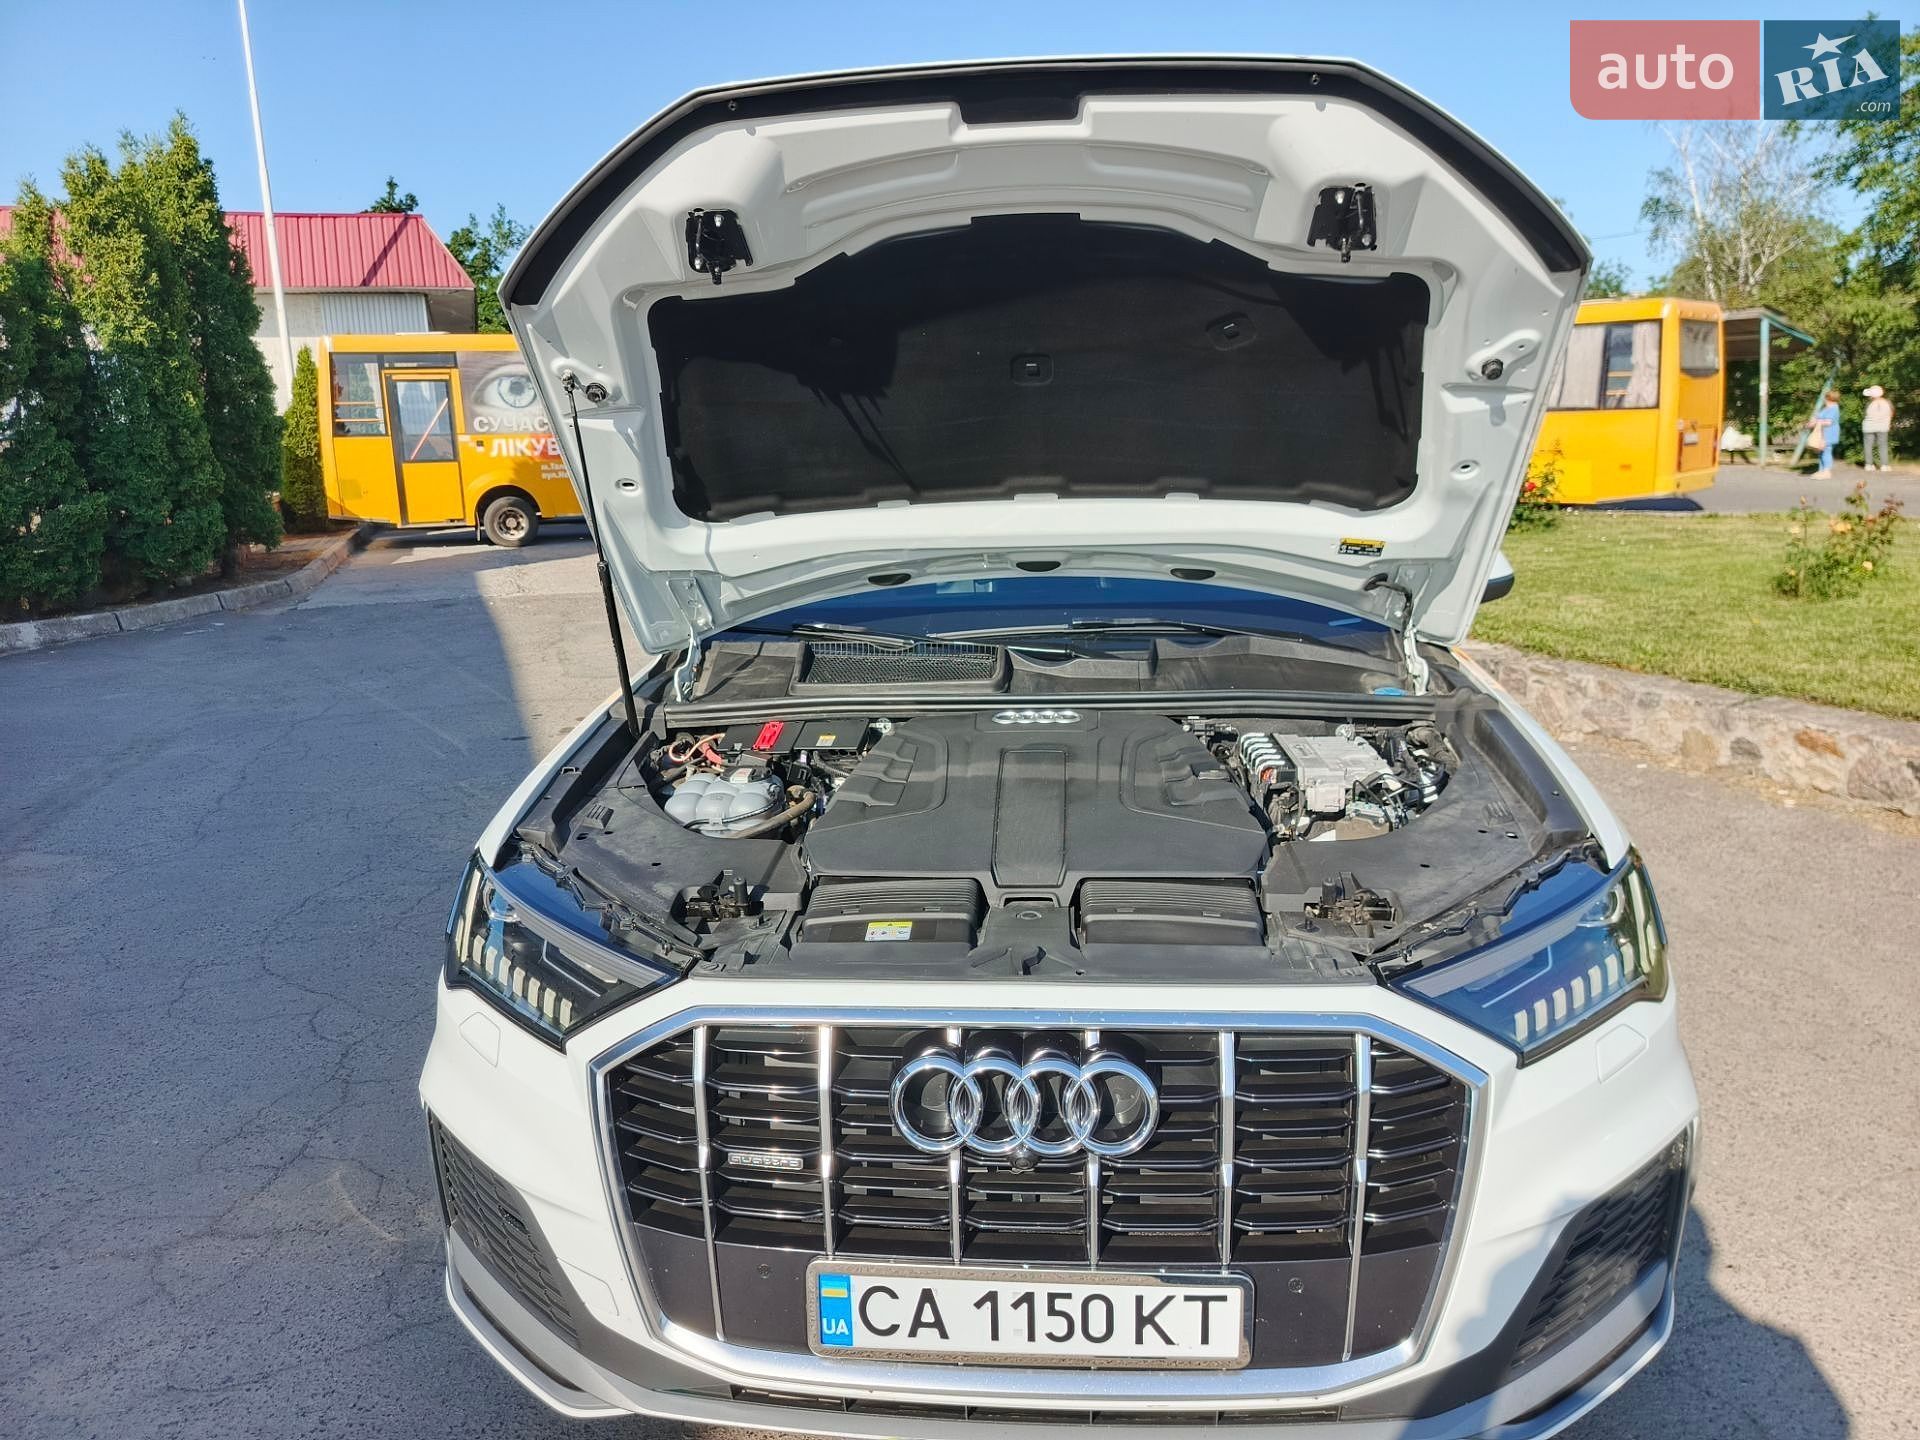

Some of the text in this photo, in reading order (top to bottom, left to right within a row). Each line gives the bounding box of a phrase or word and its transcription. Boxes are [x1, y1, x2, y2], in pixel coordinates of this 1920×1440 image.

[822, 1317, 850, 1336] UA
[858, 1285, 1229, 1346] CA 1150 KT
